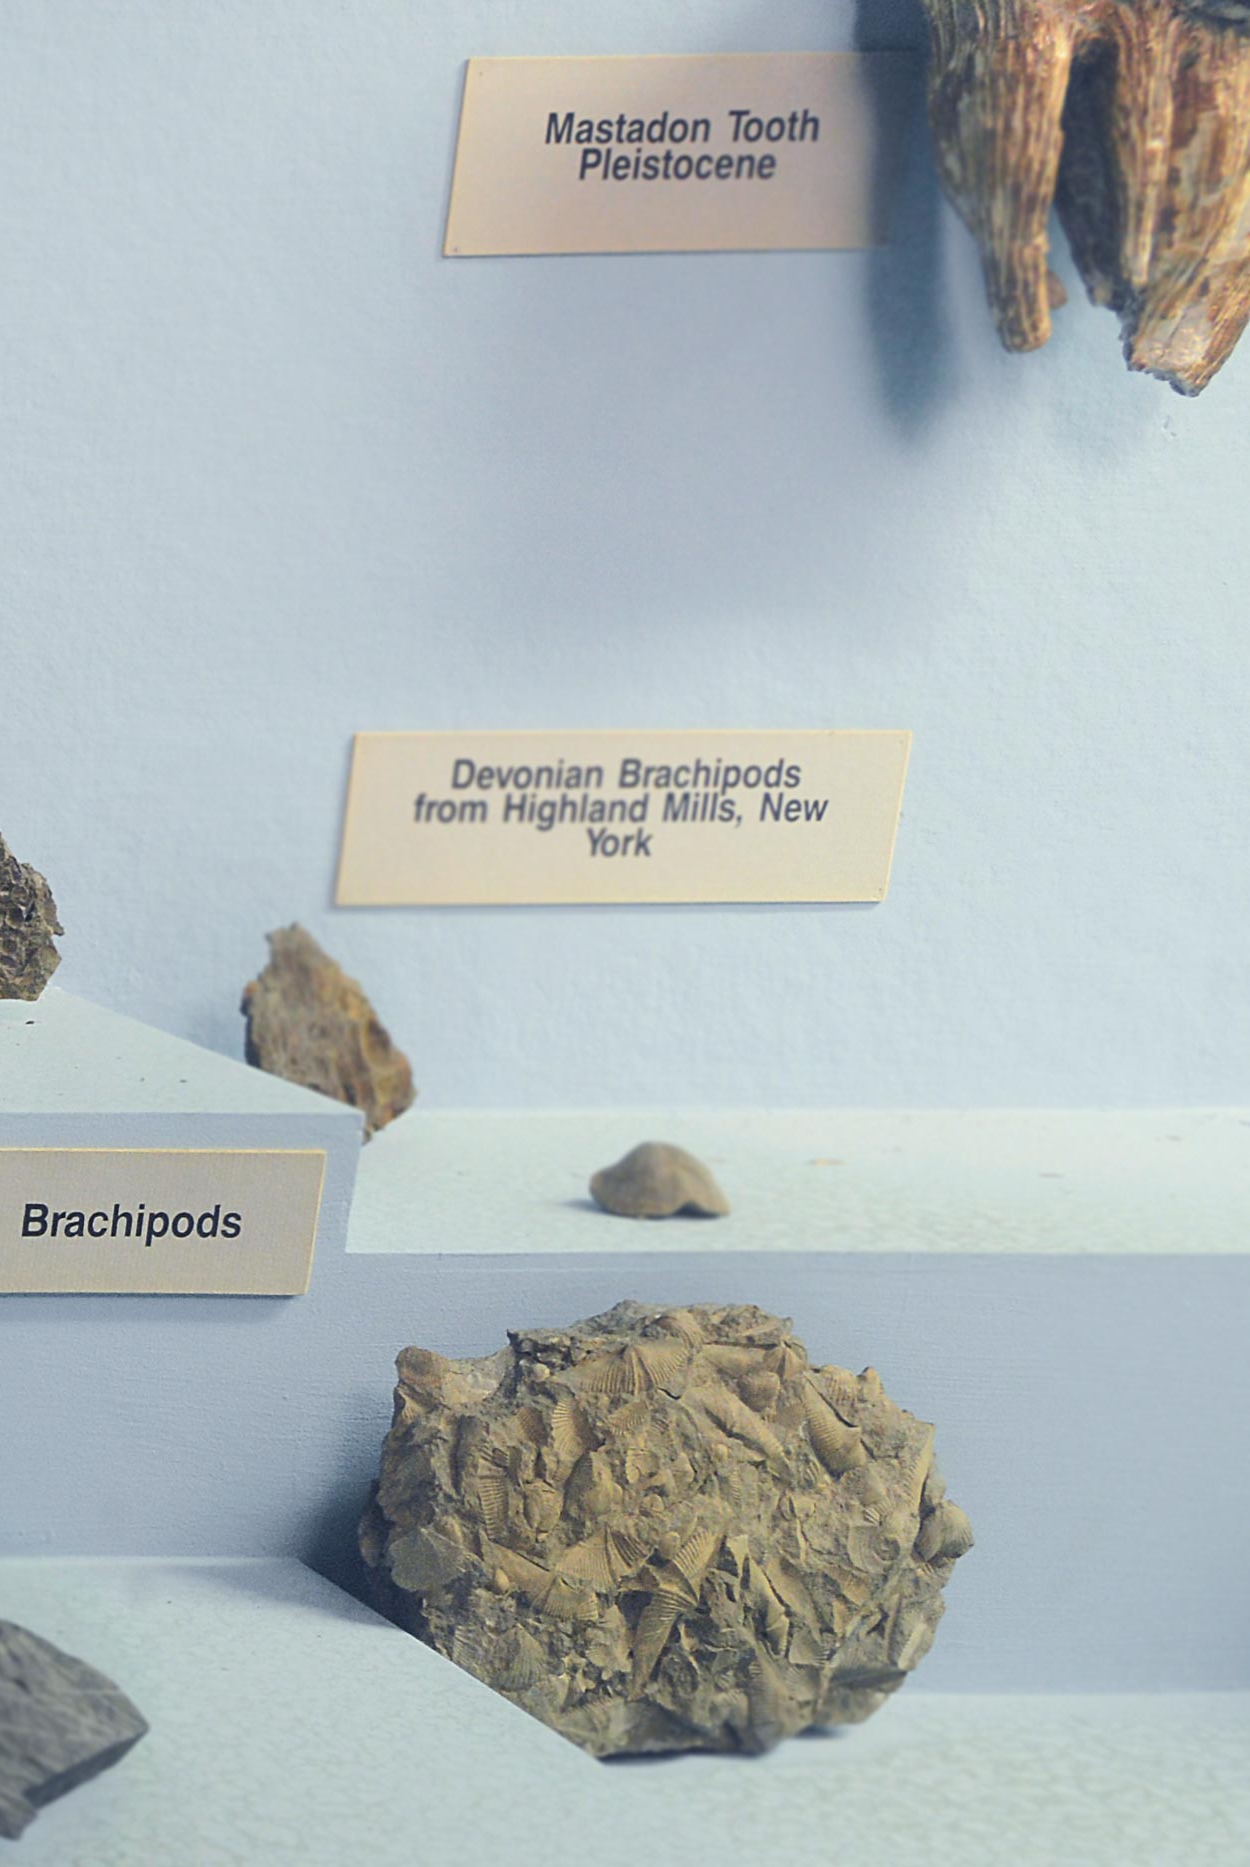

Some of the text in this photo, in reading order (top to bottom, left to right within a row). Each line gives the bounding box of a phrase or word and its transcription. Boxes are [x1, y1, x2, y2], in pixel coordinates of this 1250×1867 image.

[545, 108, 820, 144] Mastadon Tooth
[578, 147, 777, 182] Pleistocene
[451, 758, 801, 794] Devonian Brachipods
[413, 792, 829, 830] from Highland Mills, New
[585, 827, 652, 857] York
[20, 1202, 243, 1247] Brachipods
